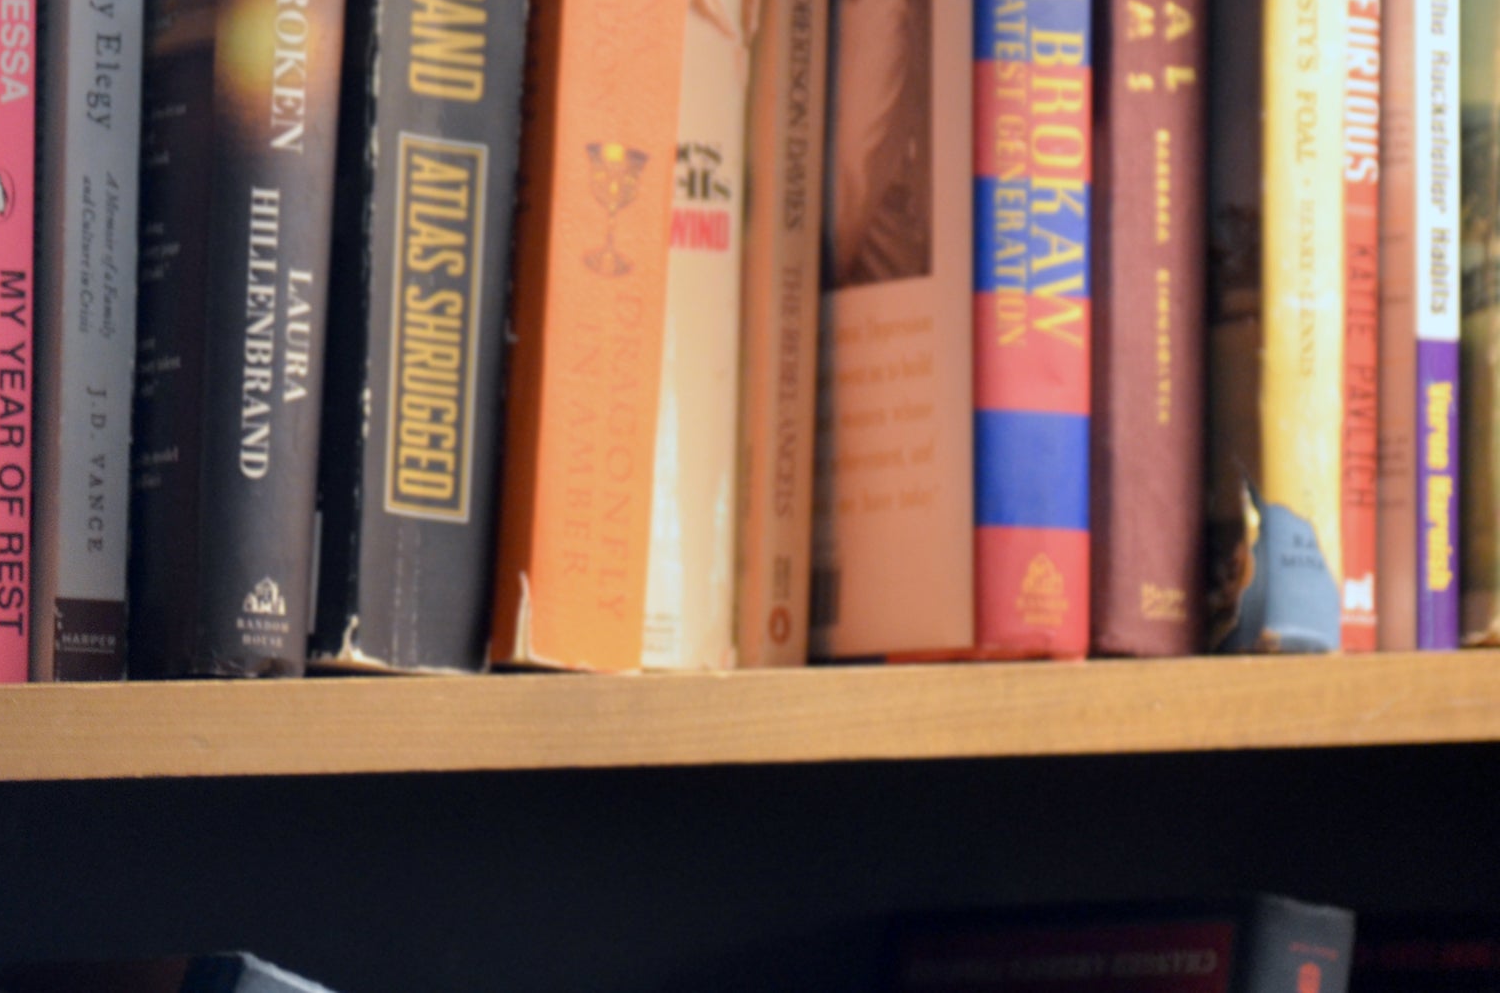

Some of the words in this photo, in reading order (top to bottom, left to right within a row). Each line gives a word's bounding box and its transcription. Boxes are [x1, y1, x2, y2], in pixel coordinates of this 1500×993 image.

[86, 33, 124, 131] Elegy
[1295, 89, 1319, 164] FOAL
[405, 153, 471, 278] ATLAS
[994, 114, 1029, 348] GENERATION
[1028, 27, 1088, 349] BROKAW
[238, 185, 281, 480] HILLENBRAND
[282, 267, 314, 403] LAURA
[1346, 242, 1378, 345] KATIE
[397, 285, 464, 502] SHRUGGED
[598, 290, 644, 623] DRAGONFLY
[1343, 362, 1377, 510] PAVLICH
[87, 454, 108, 553] VANCE
[562, 399, 598, 578] AMBER
[61, 632, 117, 647] HARPER
